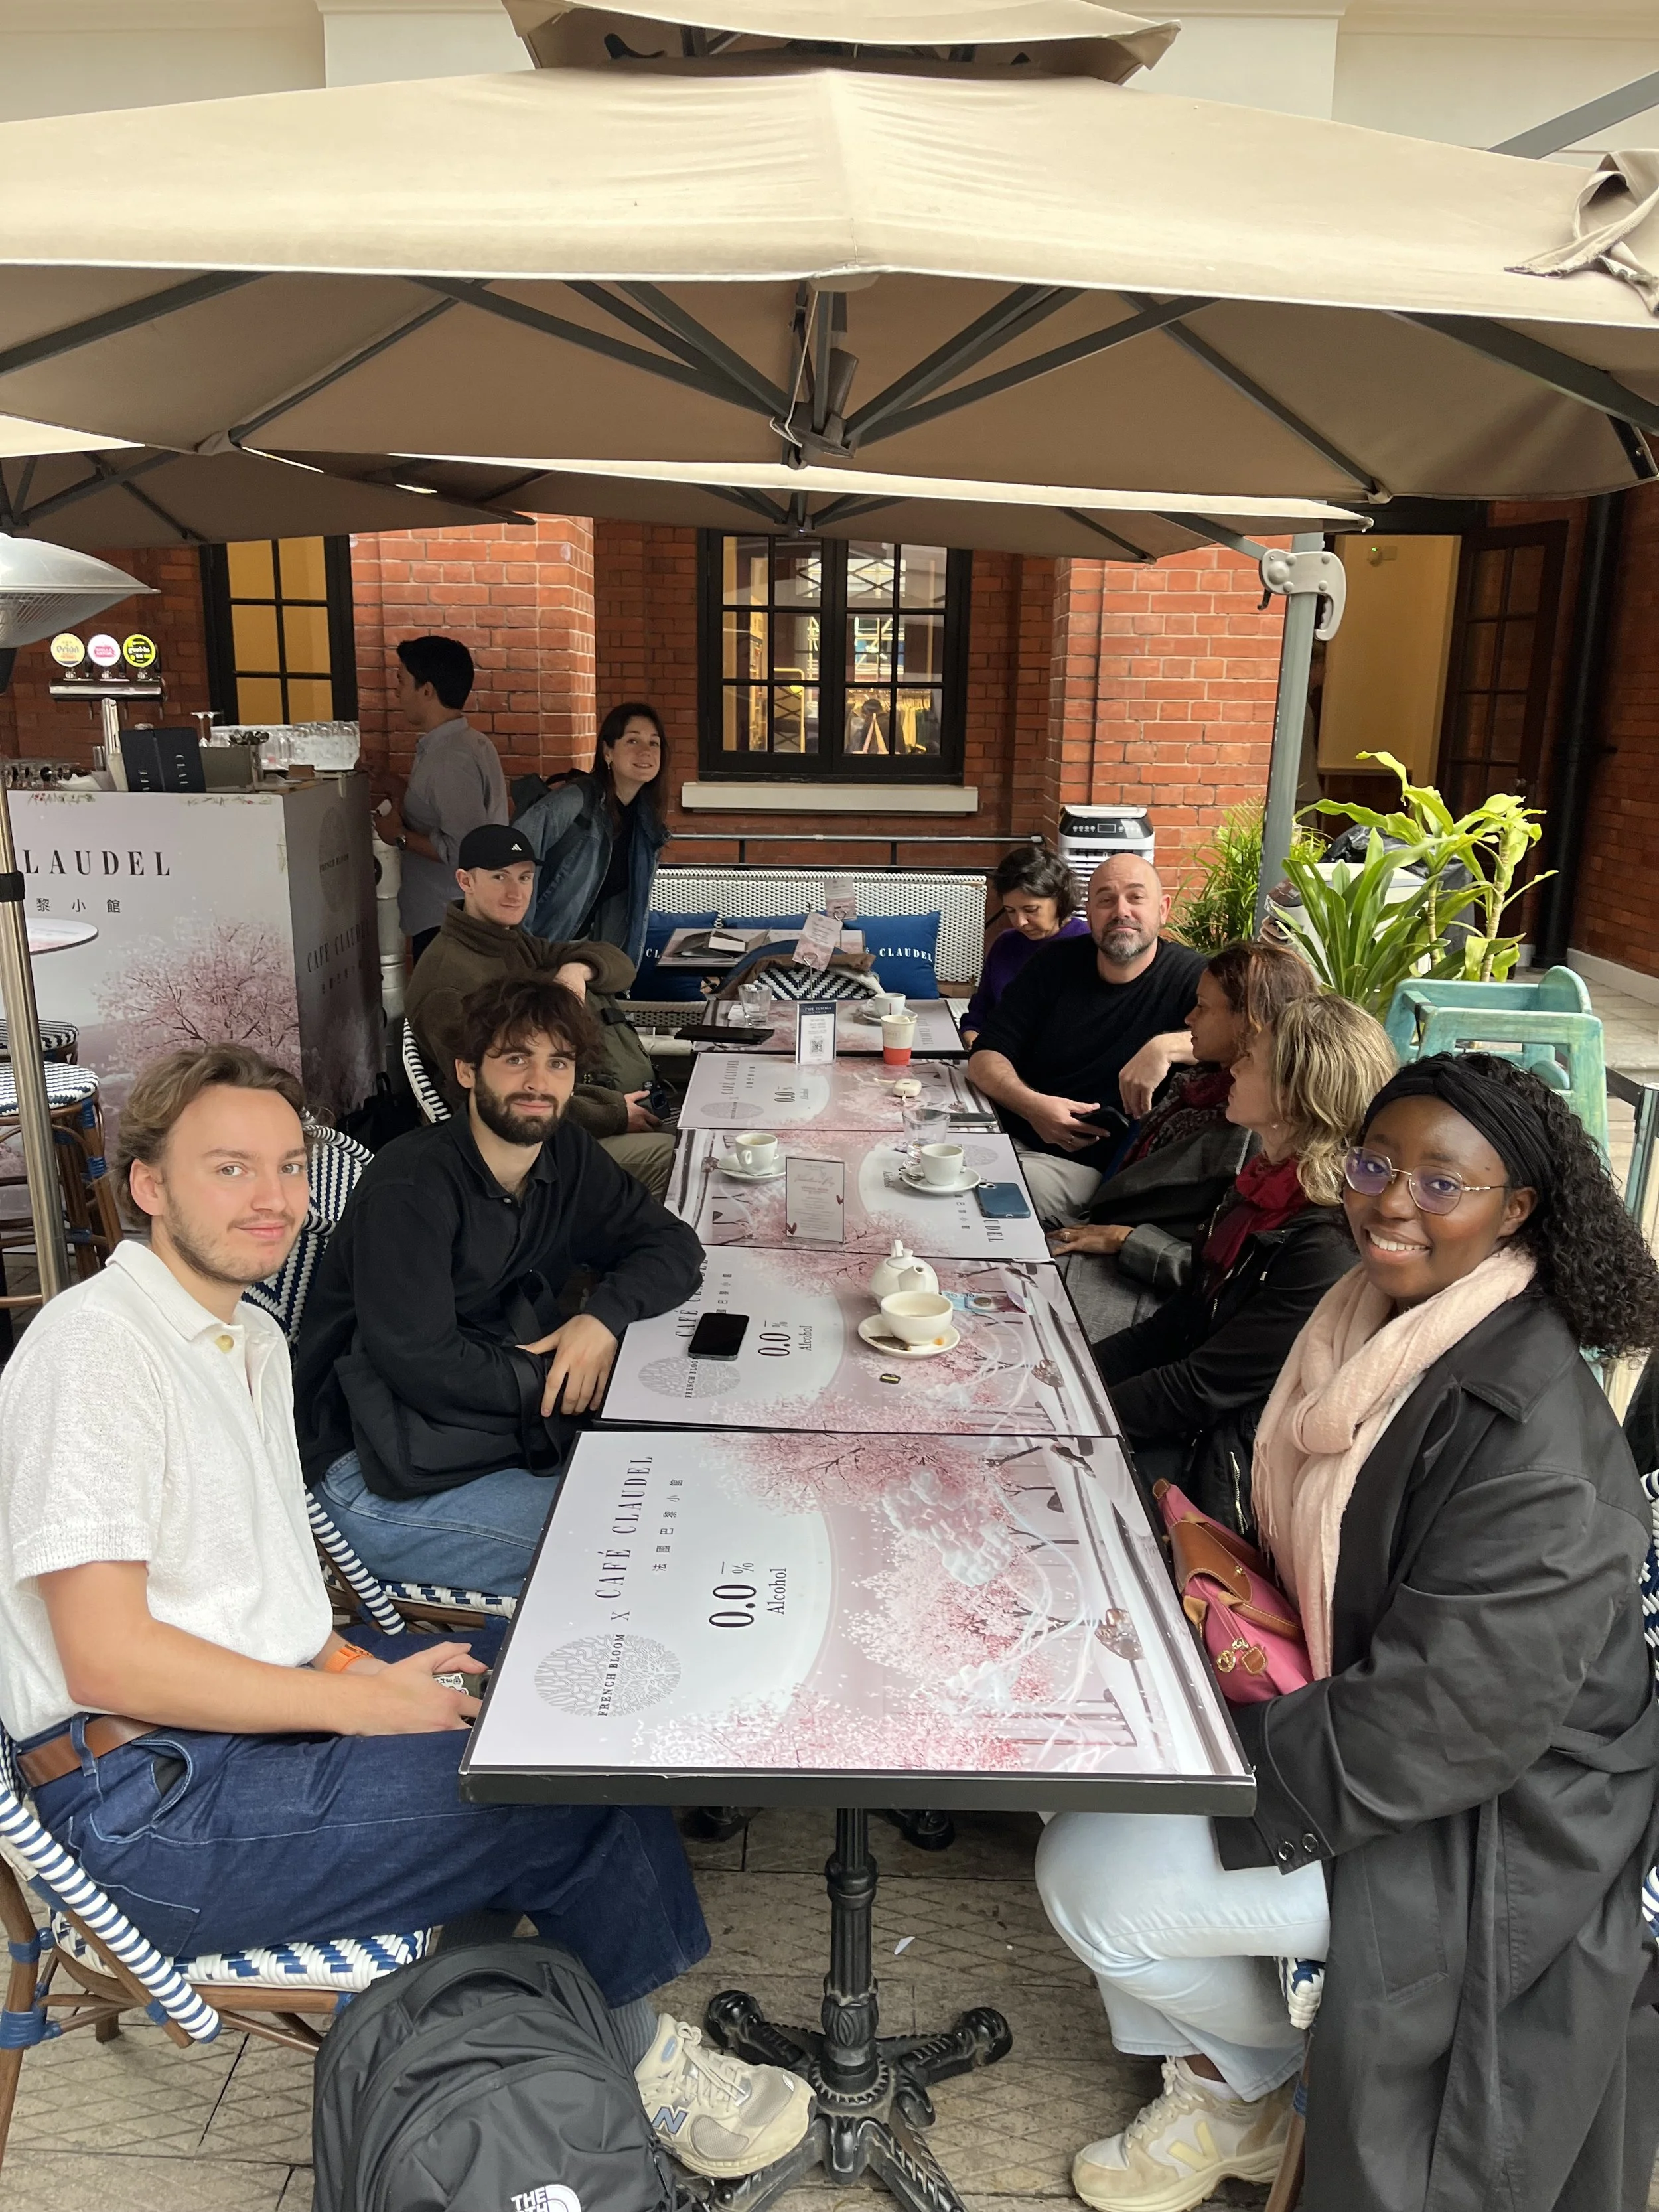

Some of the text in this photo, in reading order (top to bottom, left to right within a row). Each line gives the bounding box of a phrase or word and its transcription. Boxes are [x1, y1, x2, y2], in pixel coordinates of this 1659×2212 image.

[23, 849, 171, 876] LAUDEL
[36, 898, 121, 913] 黎小館
[646, 948, 660, 958] CL
[879, 948, 932, 962] CLAUDEL
[983, 1220, 1004, 1242] UDEL
[798, 1325, 812, 1352] Alcohol
[685, 1359, 699, 1398] FRENCH BLOO
[612, 1457, 652, 1534] CLAUDEL
[595, 1550, 631, 1598] CAFÉ
[766, 1568, 787, 1615] Alcohol
[598, 1634, 625, 1716] FRENCH BLOOM
[510, 2187, 547, 2211] THE
